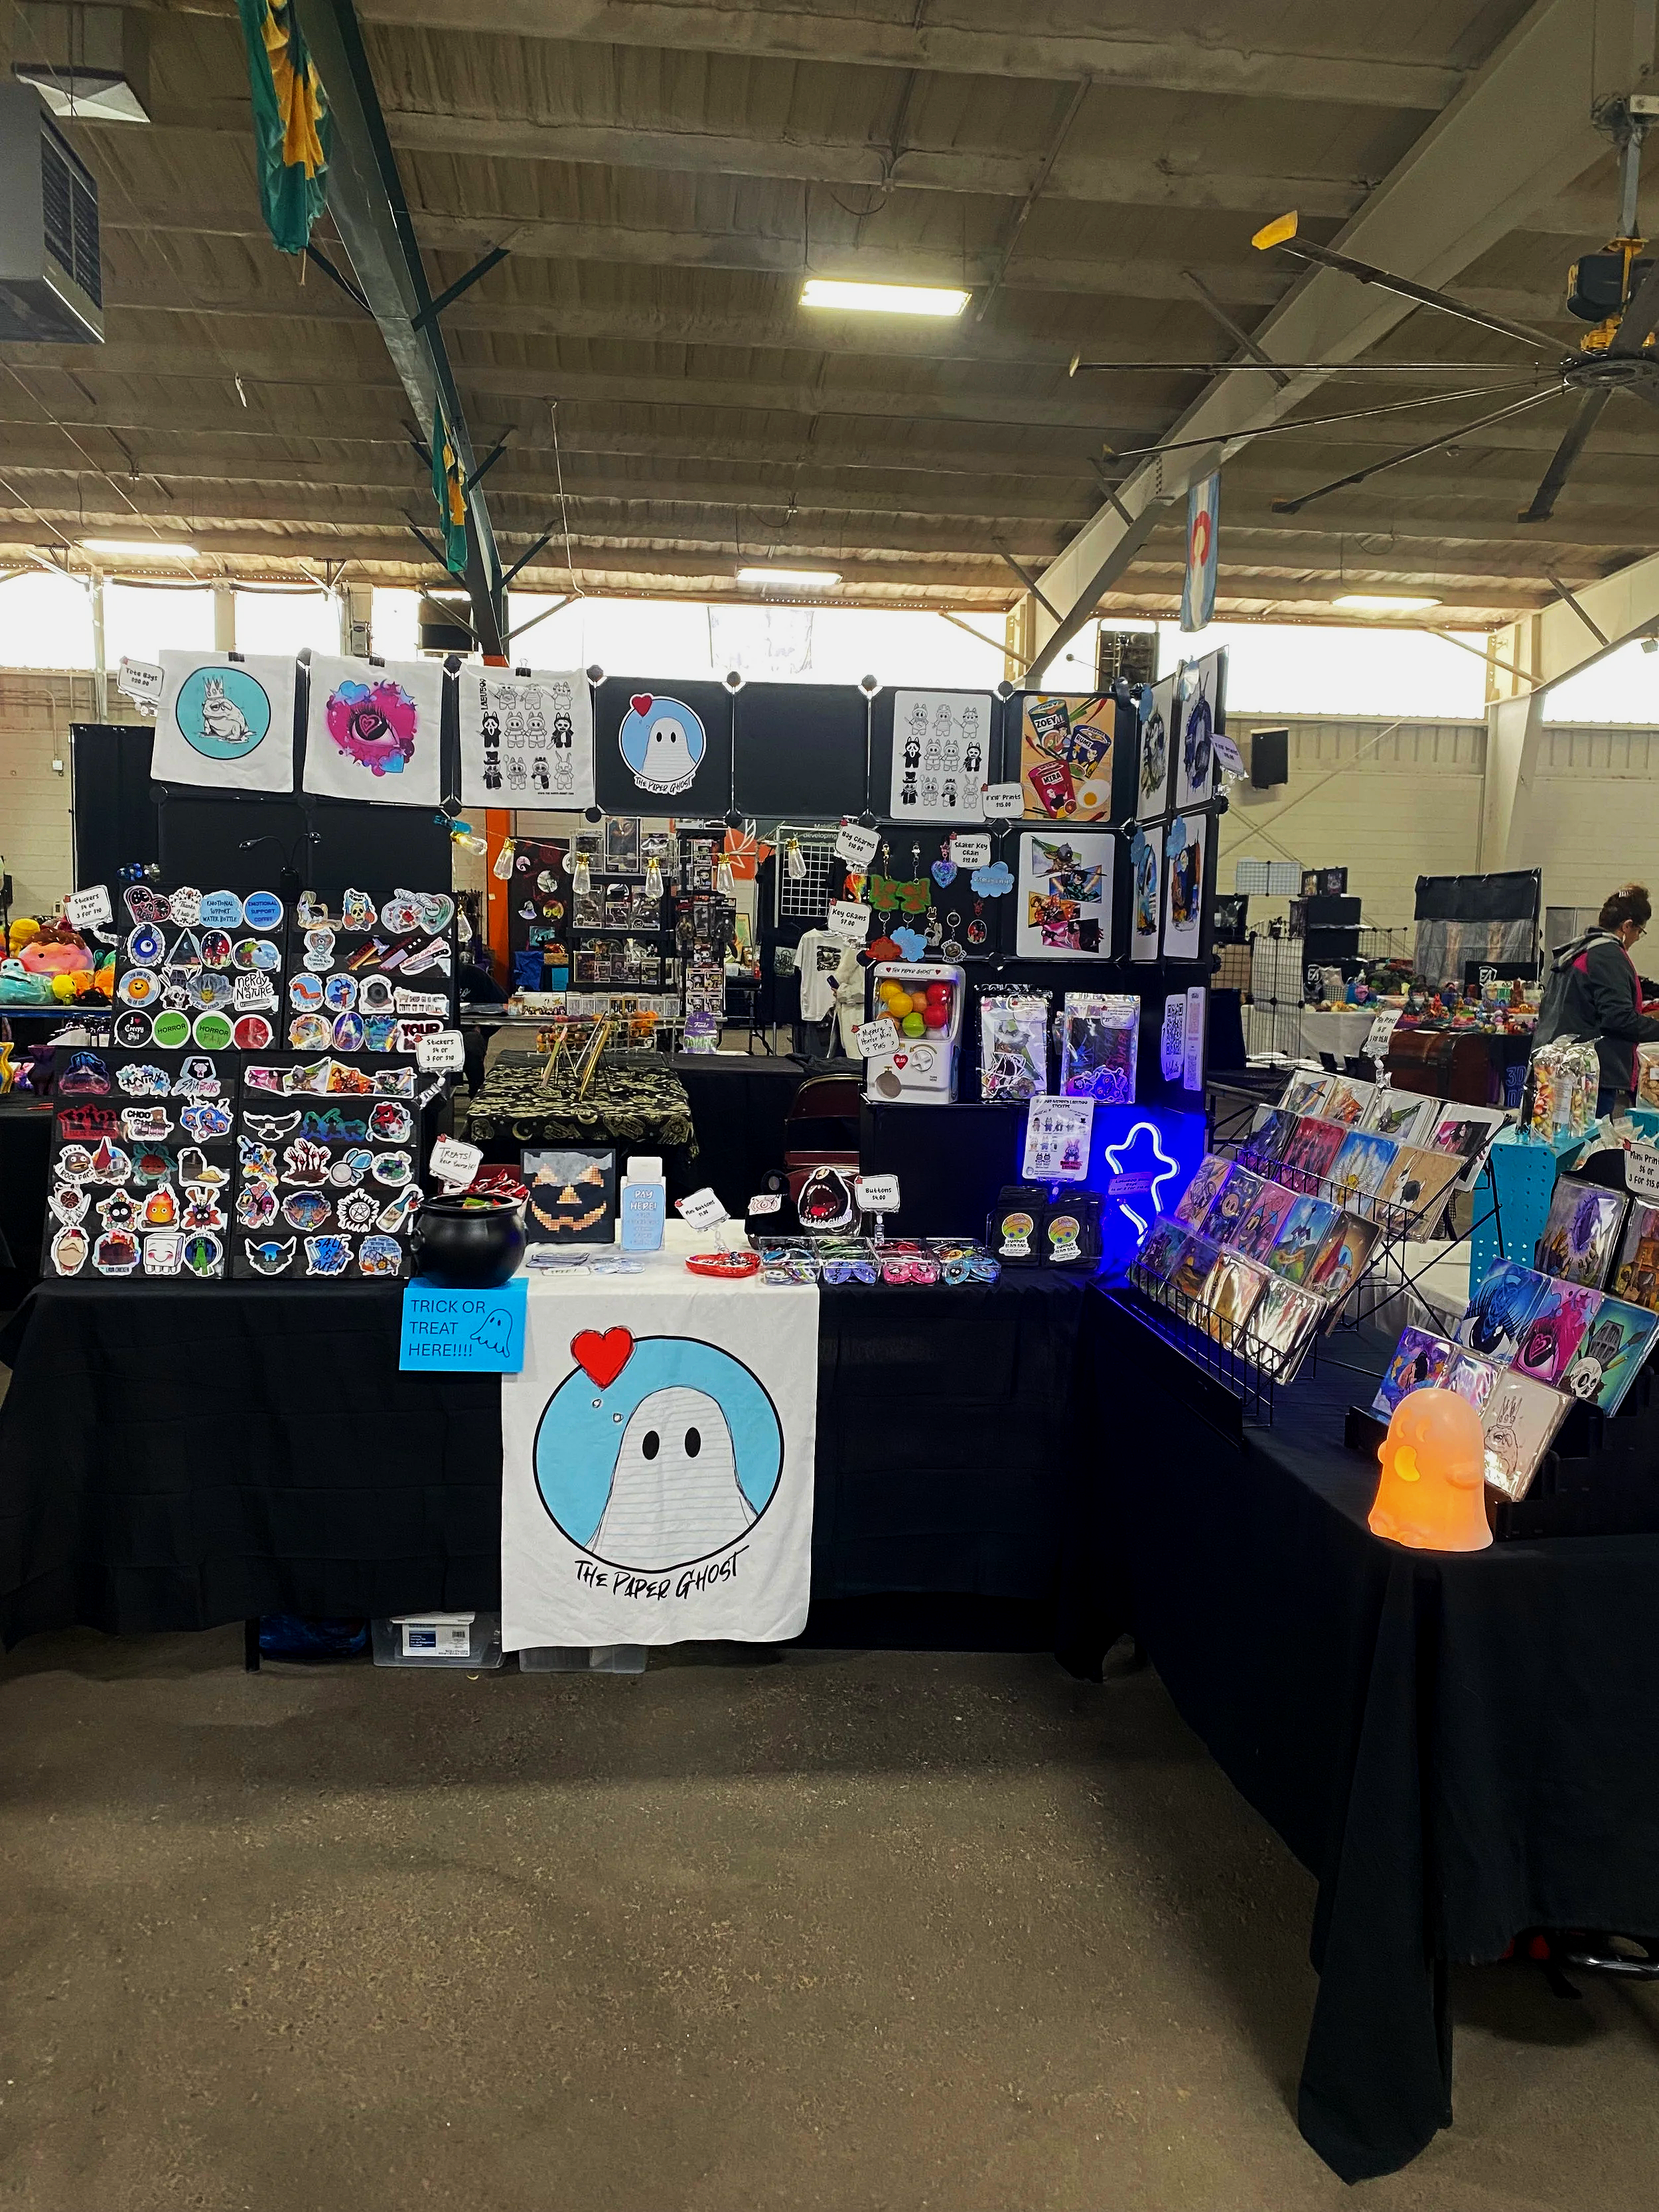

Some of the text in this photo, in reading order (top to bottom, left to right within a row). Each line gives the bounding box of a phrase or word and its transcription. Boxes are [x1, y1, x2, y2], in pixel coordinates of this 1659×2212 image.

[1035, 716, 1056, 728] ZOEY
[1075, 733, 1093, 747] RUMI
[636, 776, 647, 787] THE
[670, 773, 694, 793] GHOST
[1043, 772, 1062, 784] MIRA
[842, 831, 876, 849] Bag Charms
[848, 842, 864, 852] $10.00
[74, 893, 99, 905] Stickers
[832, 909, 867, 922] Key Chains
[157, 1024, 186, 1034] HORROR
[199, 1025, 229, 1035] HORROR
[863, 1027, 885, 1038] Mystery
[199, 1081, 218, 1094] BOYS
[439, 1147, 472, 1159] TREATS!
[1630, 1151, 1643, 1161] Mini
[1634, 1176, 1644, 1185] for
[634, 1189, 653, 1199] PAY
[630, 1202, 658, 1211] HERE!
[695, 1200, 715, 1211] Buttons
[828, 1213, 852, 1226] GHOST
[315, 1237, 343, 1250] SALT
[311, 1260, 344, 1273] BURN
[411, 1299, 485, 1313] TRICK OR
[409, 1321, 459, 1335] TREAT
[409, 1343, 472, 1357] HERE!!!!
[575, 1545, 750, 1600] THE PAPER GHOST
